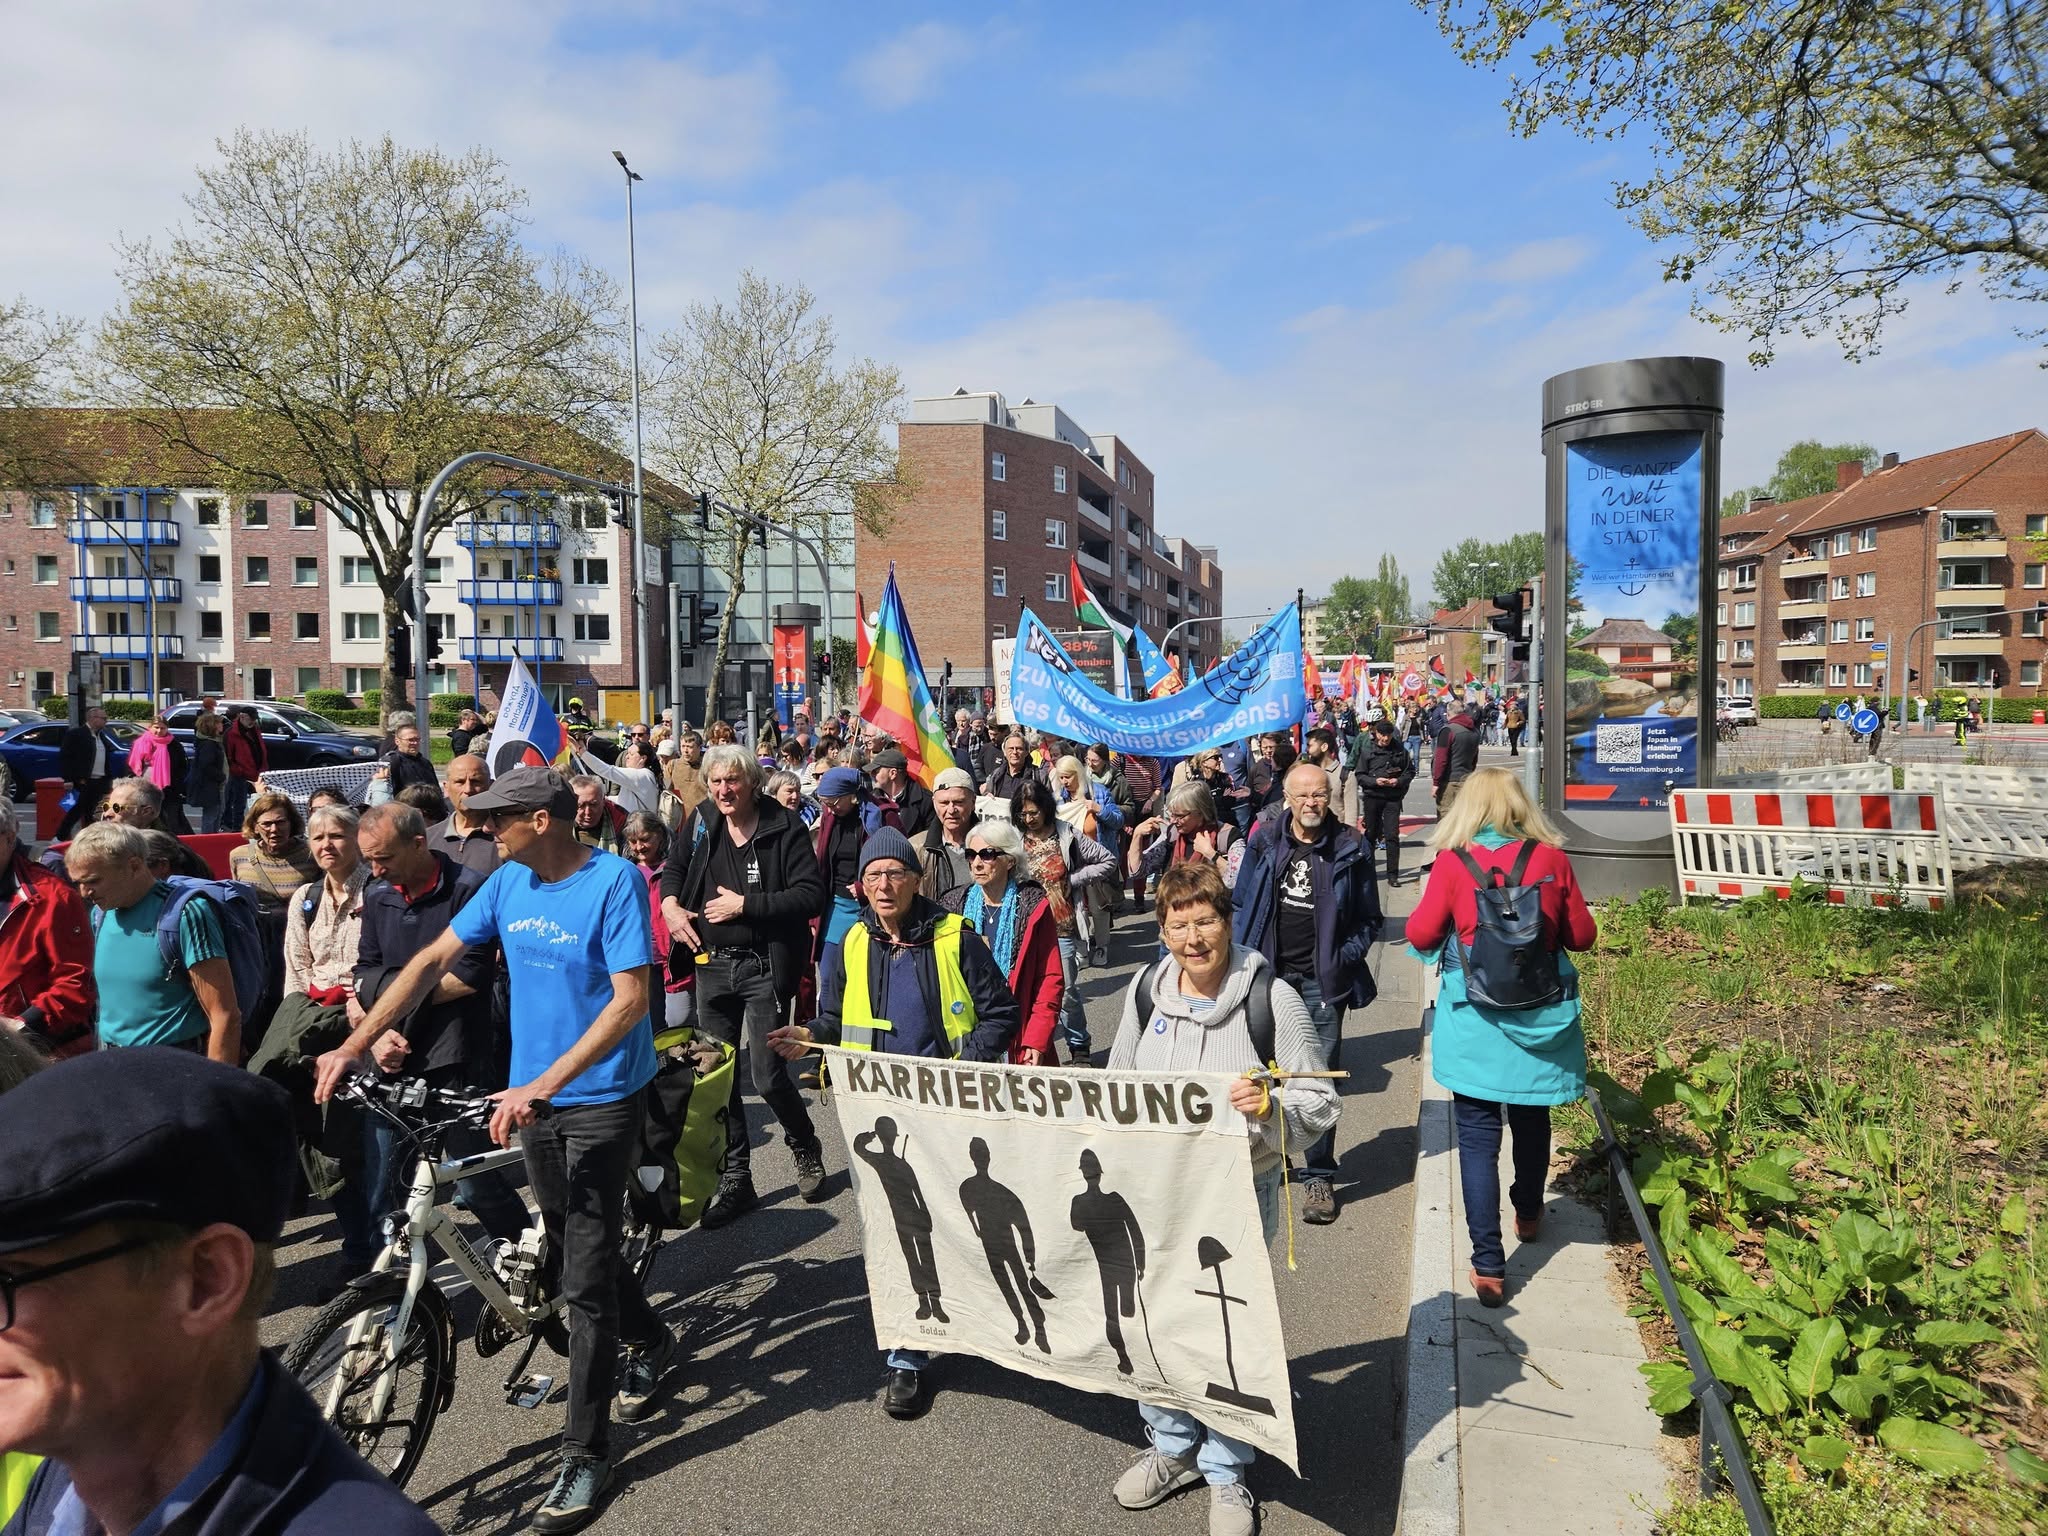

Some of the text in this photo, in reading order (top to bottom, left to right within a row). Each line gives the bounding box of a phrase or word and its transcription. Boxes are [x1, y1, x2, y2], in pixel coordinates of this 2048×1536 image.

[1588, 462, 1679, 480] DIE GANZE
[1602, 479, 1675, 506] Welt
[1591, 508, 1675, 526] IN DEINER
[1604, 528, 1663, 545] STADT.
[1623, 572, 1656, 580] Hamburg
[1658, 570, 1674, 578] sind
[1062, 640, 1098, 653] 38%
[1013, 692, 1050, 720] des
[1609, 766, 1684, 774] dieweltinhamburg.de
[847, 1058, 1214, 1125] KARRIERESPRUNG
[920, 1325, 947, 1336] Soldat
